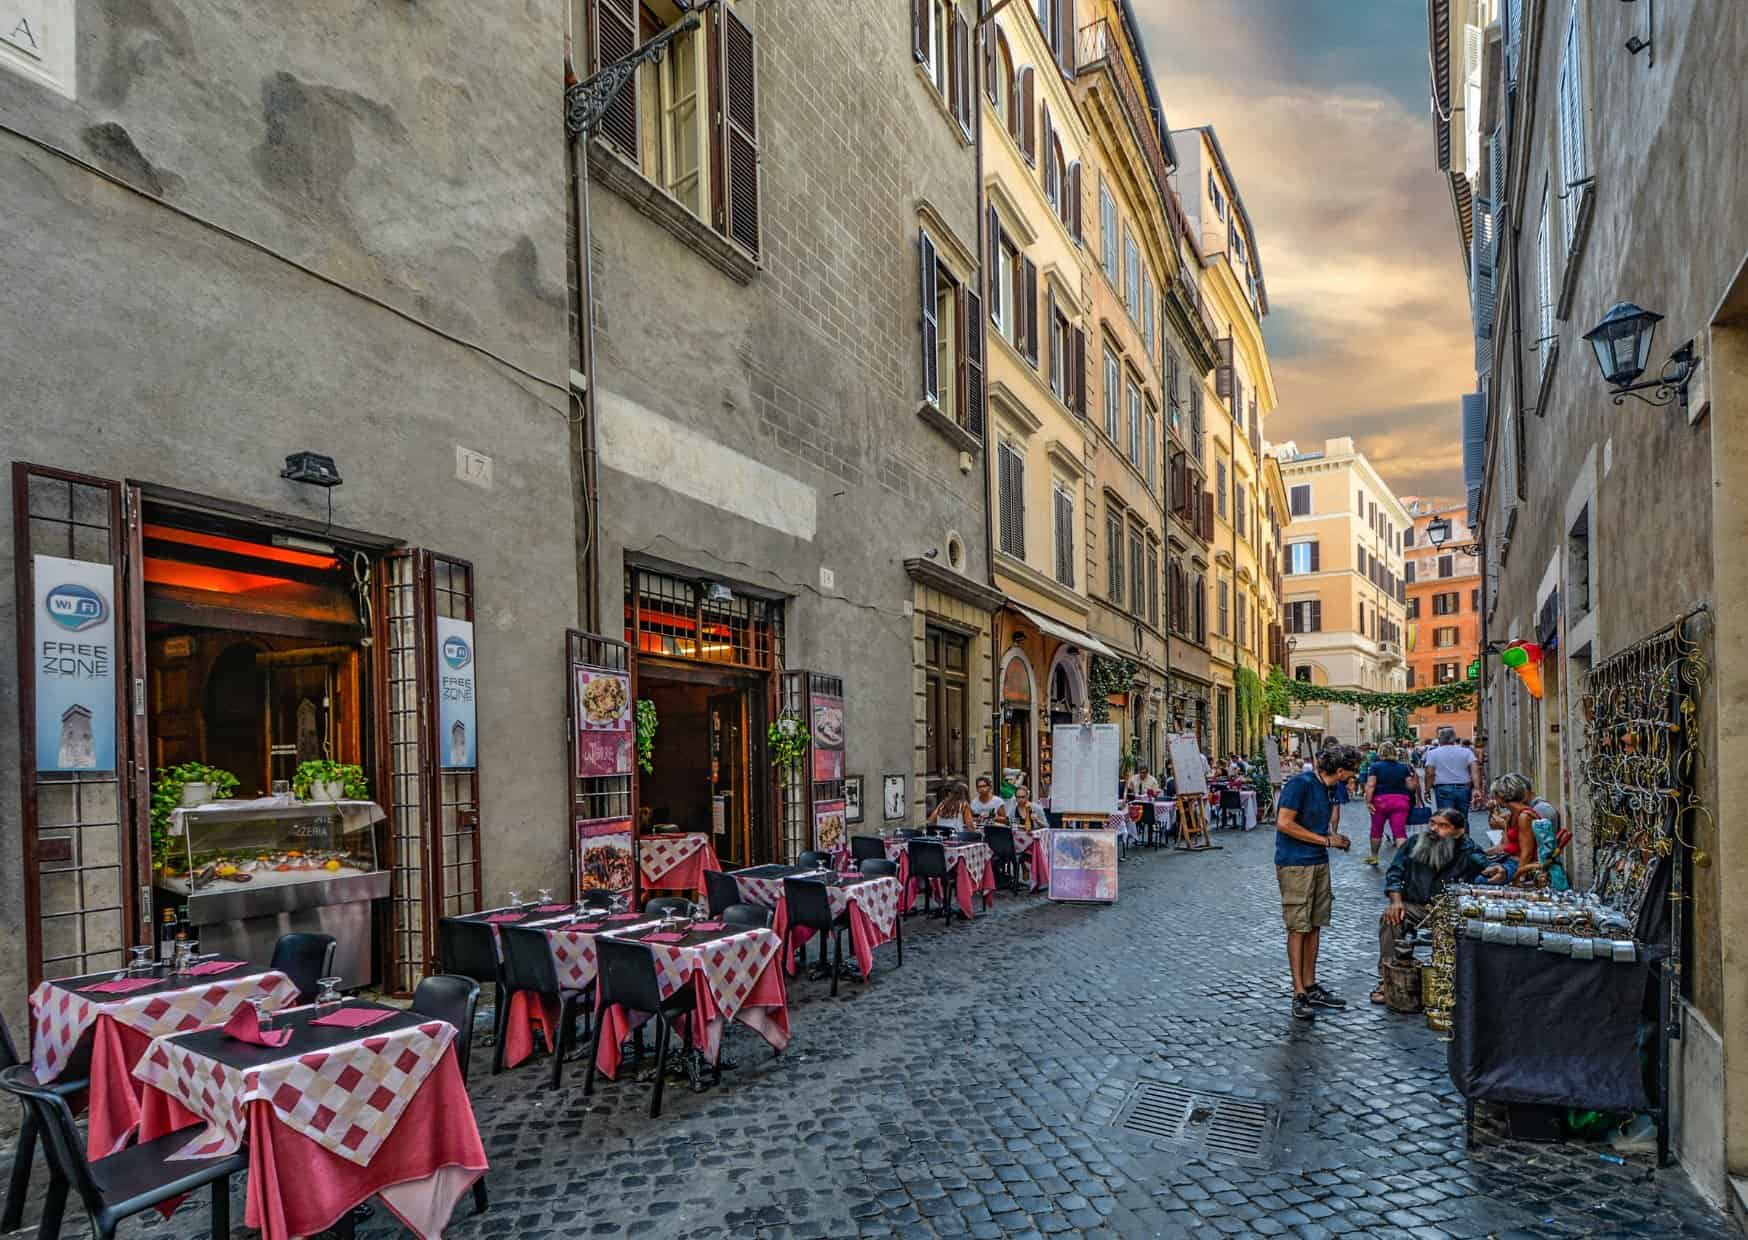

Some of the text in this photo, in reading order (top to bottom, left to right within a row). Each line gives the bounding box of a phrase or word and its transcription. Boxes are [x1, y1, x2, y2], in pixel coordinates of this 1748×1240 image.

[9, 17, 39, 50] A
[464, 454, 487, 480] 17
[43, 641, 108, 660] FREE
[43, 656, 109, 674] ZONE
[443, 676, 472, 688] FREE
[442, 687, 473, 701] ZONE
